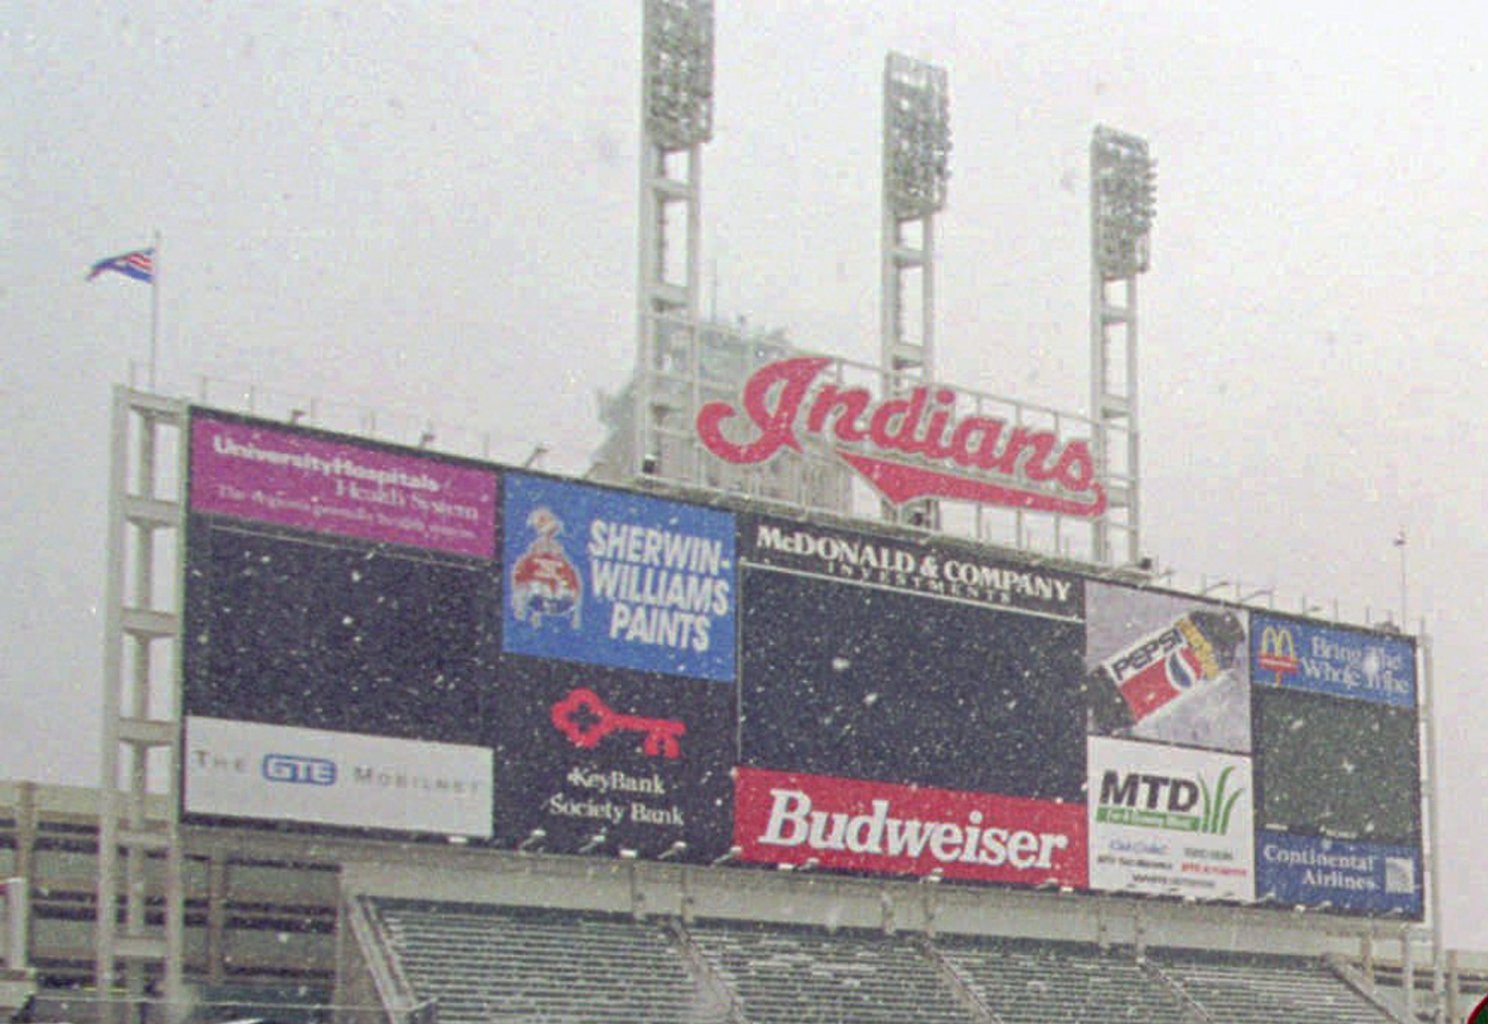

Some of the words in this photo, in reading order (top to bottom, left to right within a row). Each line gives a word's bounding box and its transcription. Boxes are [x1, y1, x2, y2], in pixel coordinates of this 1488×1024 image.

[695, 356, 1103, 492] Indians
[587, 518, 731, 576] SHERWIN-
[756, 525, 914, 575] McDONALD
[919, 555, 940, 579] &
[943, 560, 1071, 602] COMPANY
[590, 558, 730, 616] WILLIAMS
[609, 601, 712, 652] PAINTS
[1111, 627, 1185, 681] PEPSI
[266, 757, 336, 785] GTE
[1099, 769, 1200, 813] MTD
[549, 791, 625, 825] Society
[631, 801, 685, 827] Bank
[758, 787, 1069, 870] Budweiser
[1263, 843, 1375, 872] Continental
[1302, 868, 1376, 891] Airlines
